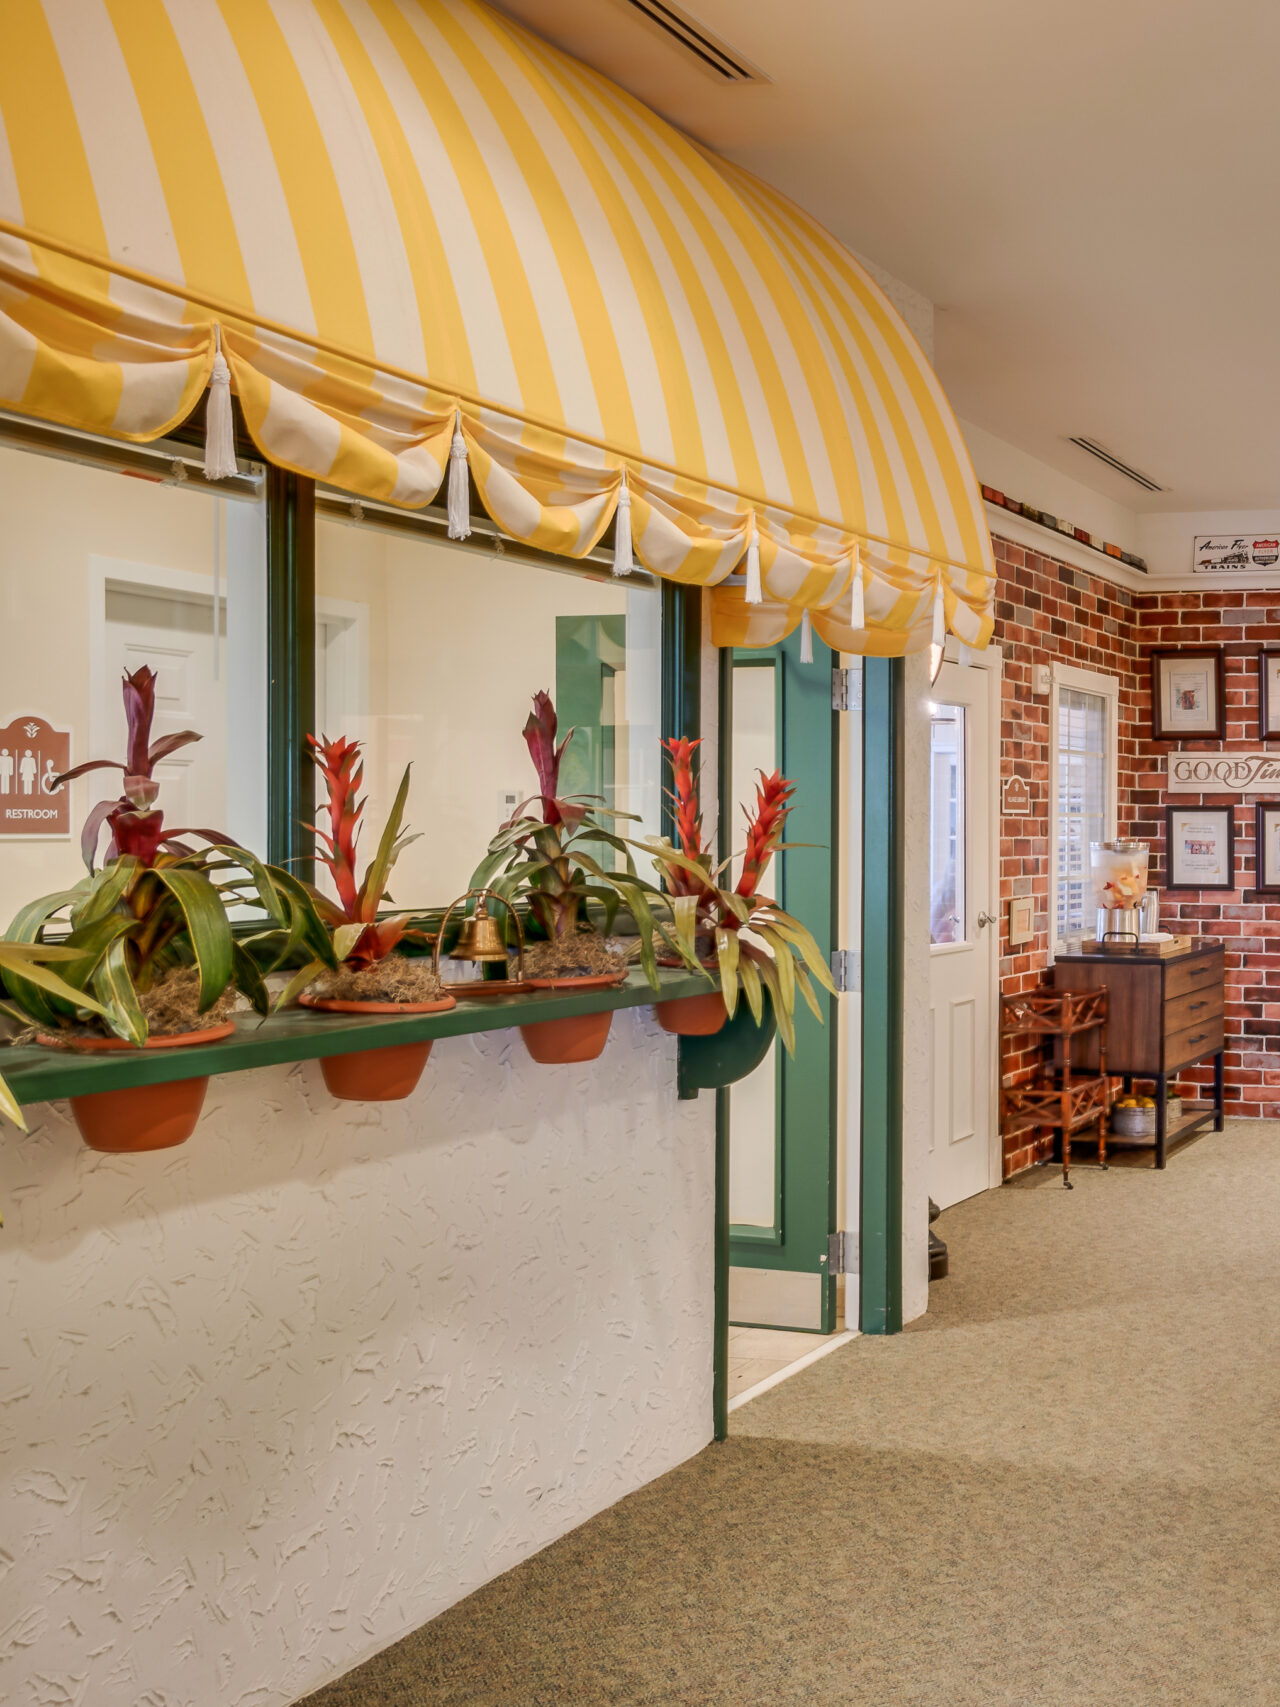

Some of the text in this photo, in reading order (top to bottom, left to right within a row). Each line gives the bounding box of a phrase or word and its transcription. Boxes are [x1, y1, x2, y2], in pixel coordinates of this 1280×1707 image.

[1199, 539, 1249, 552] American Flyer
[1174, 760, 1253, 781] GOOD
[5, 808, 58, 819] RESTROOM
